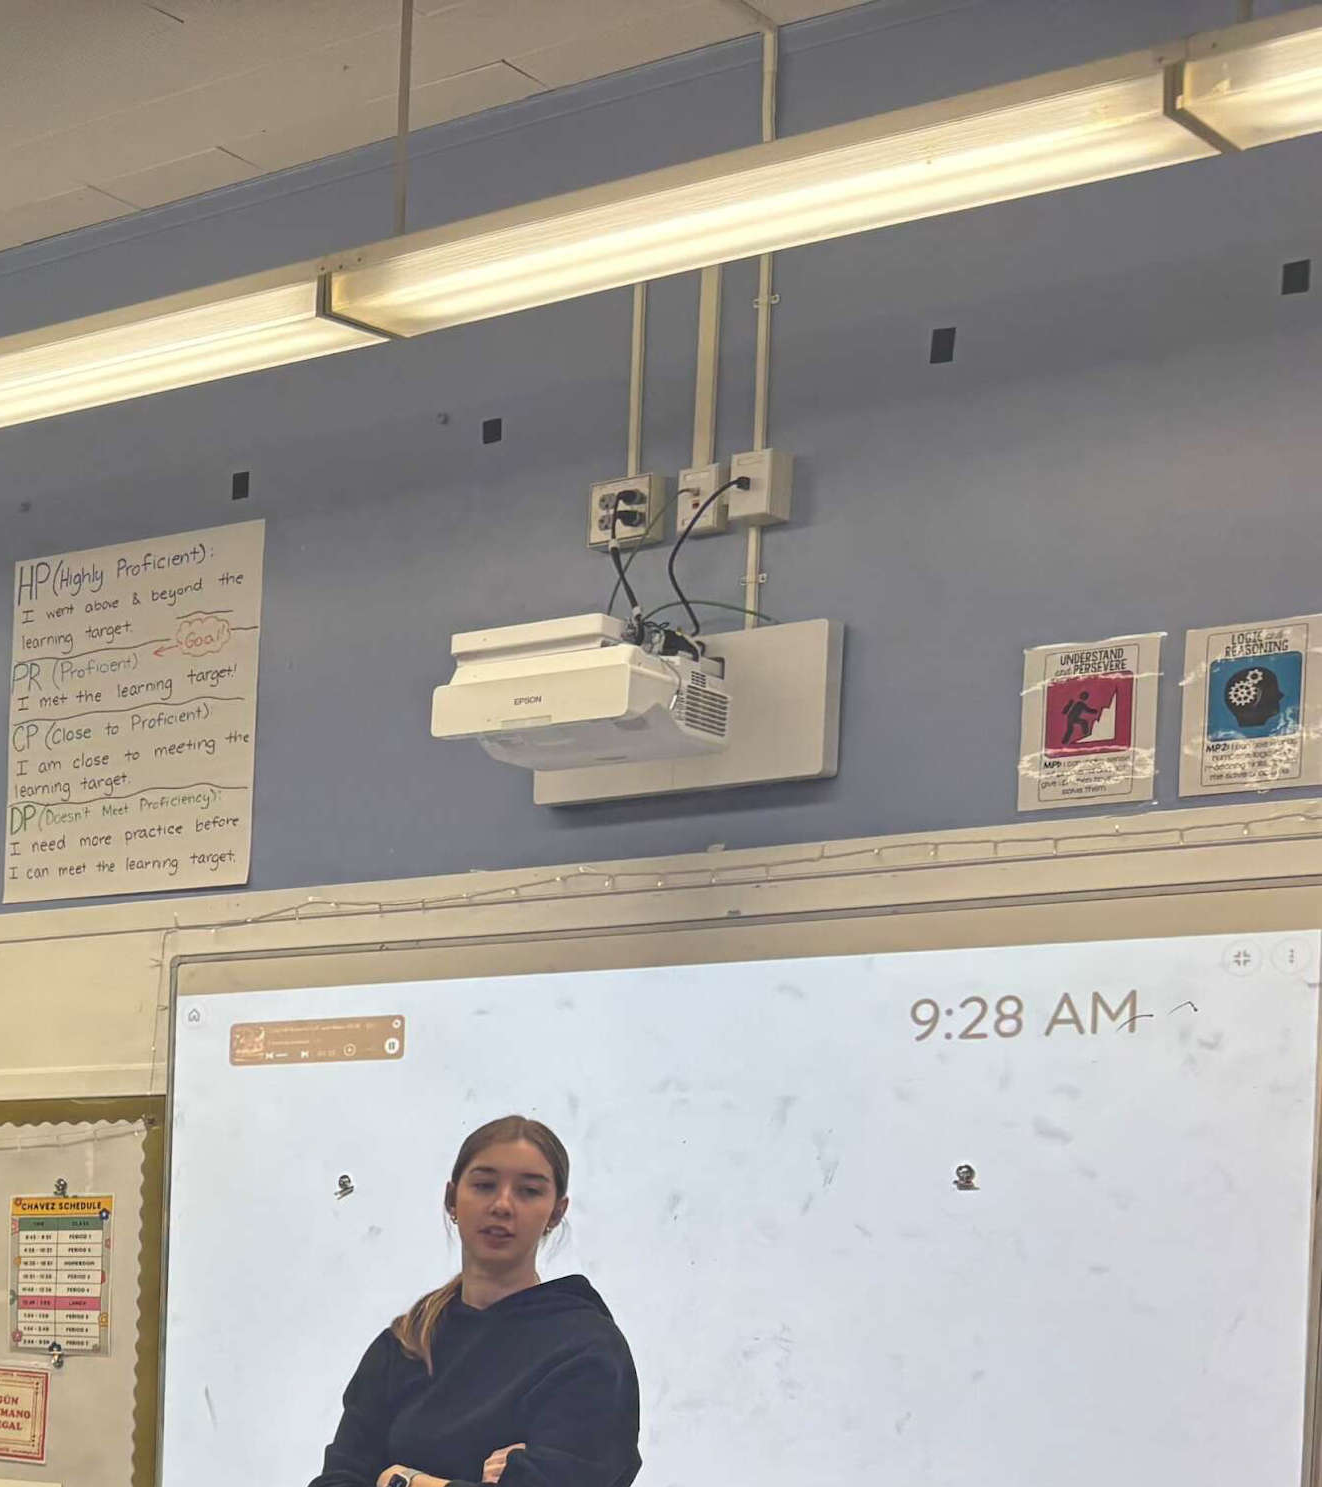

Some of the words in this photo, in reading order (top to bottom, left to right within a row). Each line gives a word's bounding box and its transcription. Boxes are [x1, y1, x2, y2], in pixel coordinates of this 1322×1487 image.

[17, 562, 51, 606] HP
[21, 610, 35, 624] I
[46, 604, 75, 621] went
[85, 597, 119, 613] above
[132, 594, 141, 605] &
[151, 578, 203, 606] beyond
[218, 572, 244, 586] the
[21, 633, 74, 654] learning
[1060, 648, 1124, 667] UNDERSTAND
[1225, 639, 1289, 658] REASONING
[12, 662, 42, 694] PR
[1073, 659, 1128, 675] PERSEVERE
[18, 696, 30, 711] I
[40, 693, 68, 708] met
[76, 689, 102, 703] the
[117, 678, 173, 700] learning
[514, 695, 542, 706] EPSON
[12, 723, 38, 753] CP
[44, 722, 92, 750] (Close
[106, 724, 119, 737] to
[16, 759, 29, 776] I
[38, 761, 62, 774] am
[73, 754, 110, 769] close
[125, 751, 140, 761] to
[154, 737, 216, 757] meeting
[225, 730, 249, 744] the
[15, 781, 71, 801] learning
[10, 804, 37, 836] DP
[102, 804, 129, 817] Meet
[10, 841, 21, 856] I
[31, 838, 66, 853] need
[80, 835, 112, 848] more
[125, 824, 183, 844] practice
[195, 816, 240, 833] before
[9, 866, 18, 880] I
[26, 867, 49, 880] can
[58, 863, 86, 876] meet
[96, 861, 115, 873] the
[125, 858, 179, 876] learning
[910, 995, 1024, 1042] 9:28
[1044, 989, 1137, 1037] AM
[21, 1202, 55, 1210] CHAVEZ
[58, 1201, 101, 1210] SCHEDULE
